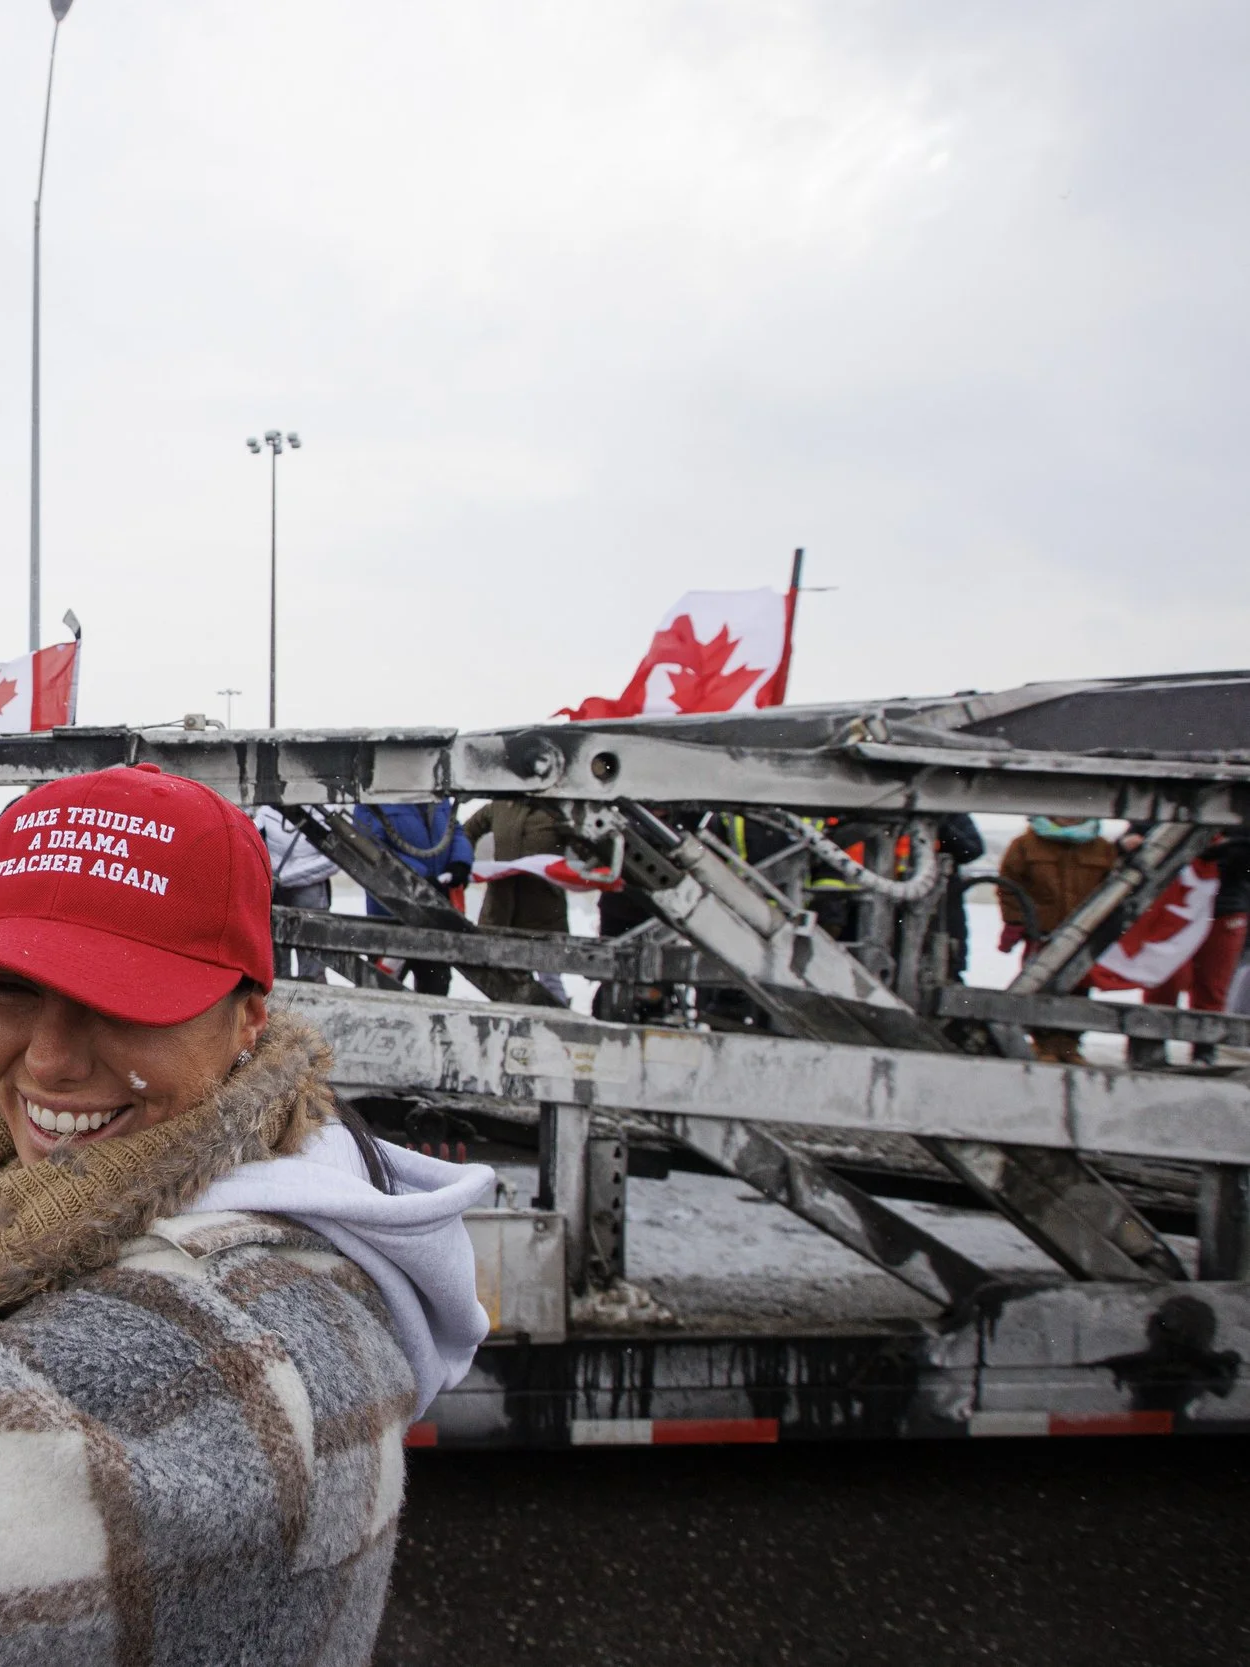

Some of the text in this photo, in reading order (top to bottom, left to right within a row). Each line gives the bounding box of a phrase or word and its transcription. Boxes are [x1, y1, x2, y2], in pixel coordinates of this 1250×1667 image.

[14, 807, 175, 843] MAKE TRUDEAU
[28, 830, 129, 858] A DRAMA
[89, 859, 169, 896] AGAIN
